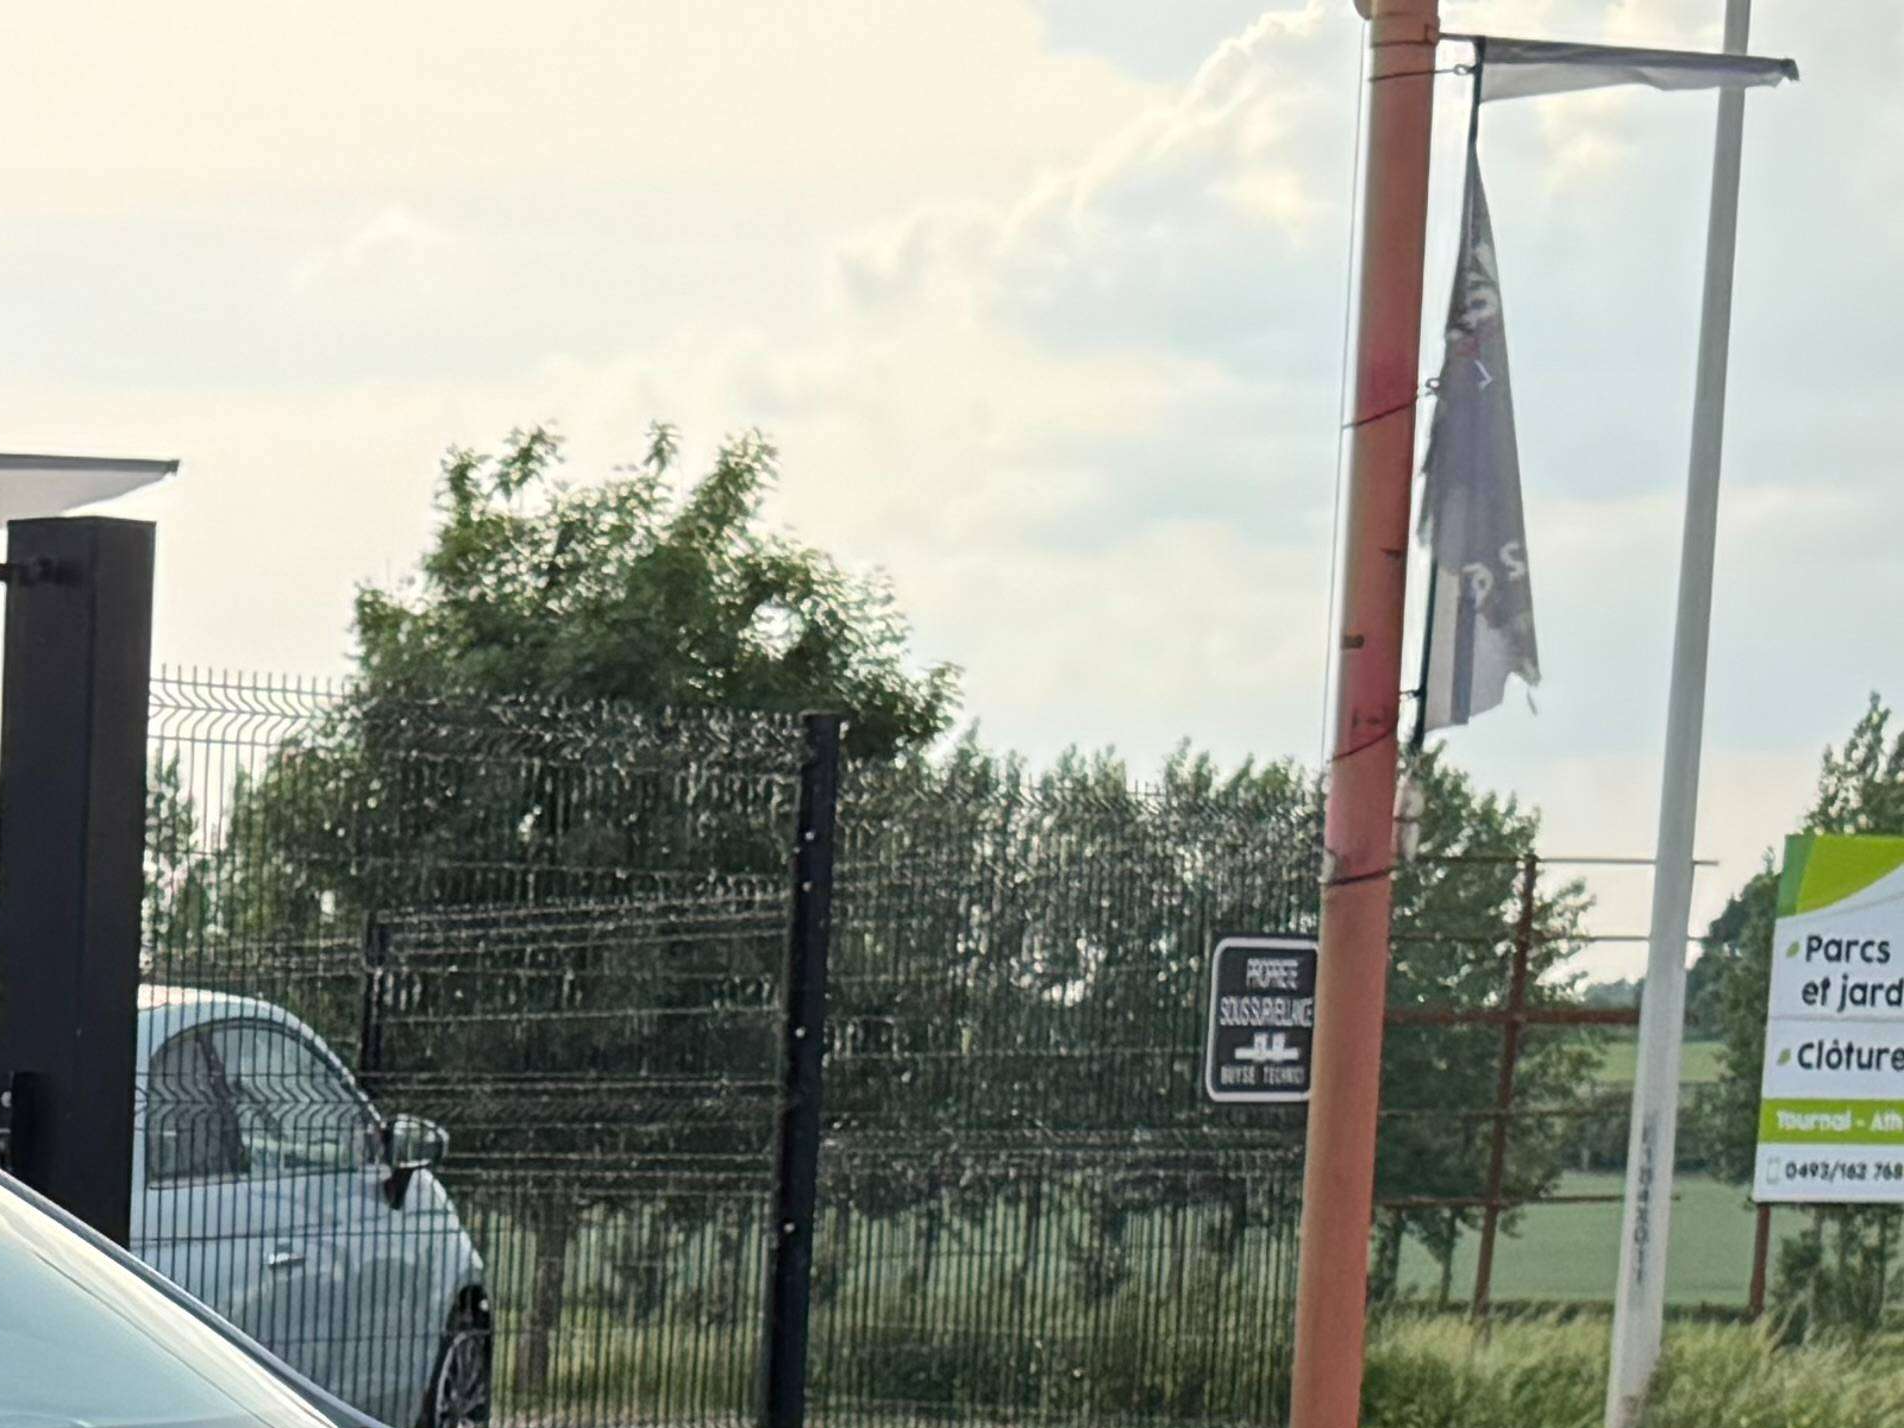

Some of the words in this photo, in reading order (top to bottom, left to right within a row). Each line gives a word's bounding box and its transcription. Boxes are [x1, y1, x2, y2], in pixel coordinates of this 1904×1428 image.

[1805, 934, 1891, 964] Parcs
[1801, 976, 1831, 1006] et
[1836, 972, 1904, 1013] jard
[1776, 1109, 1852, 1132] Tournai
